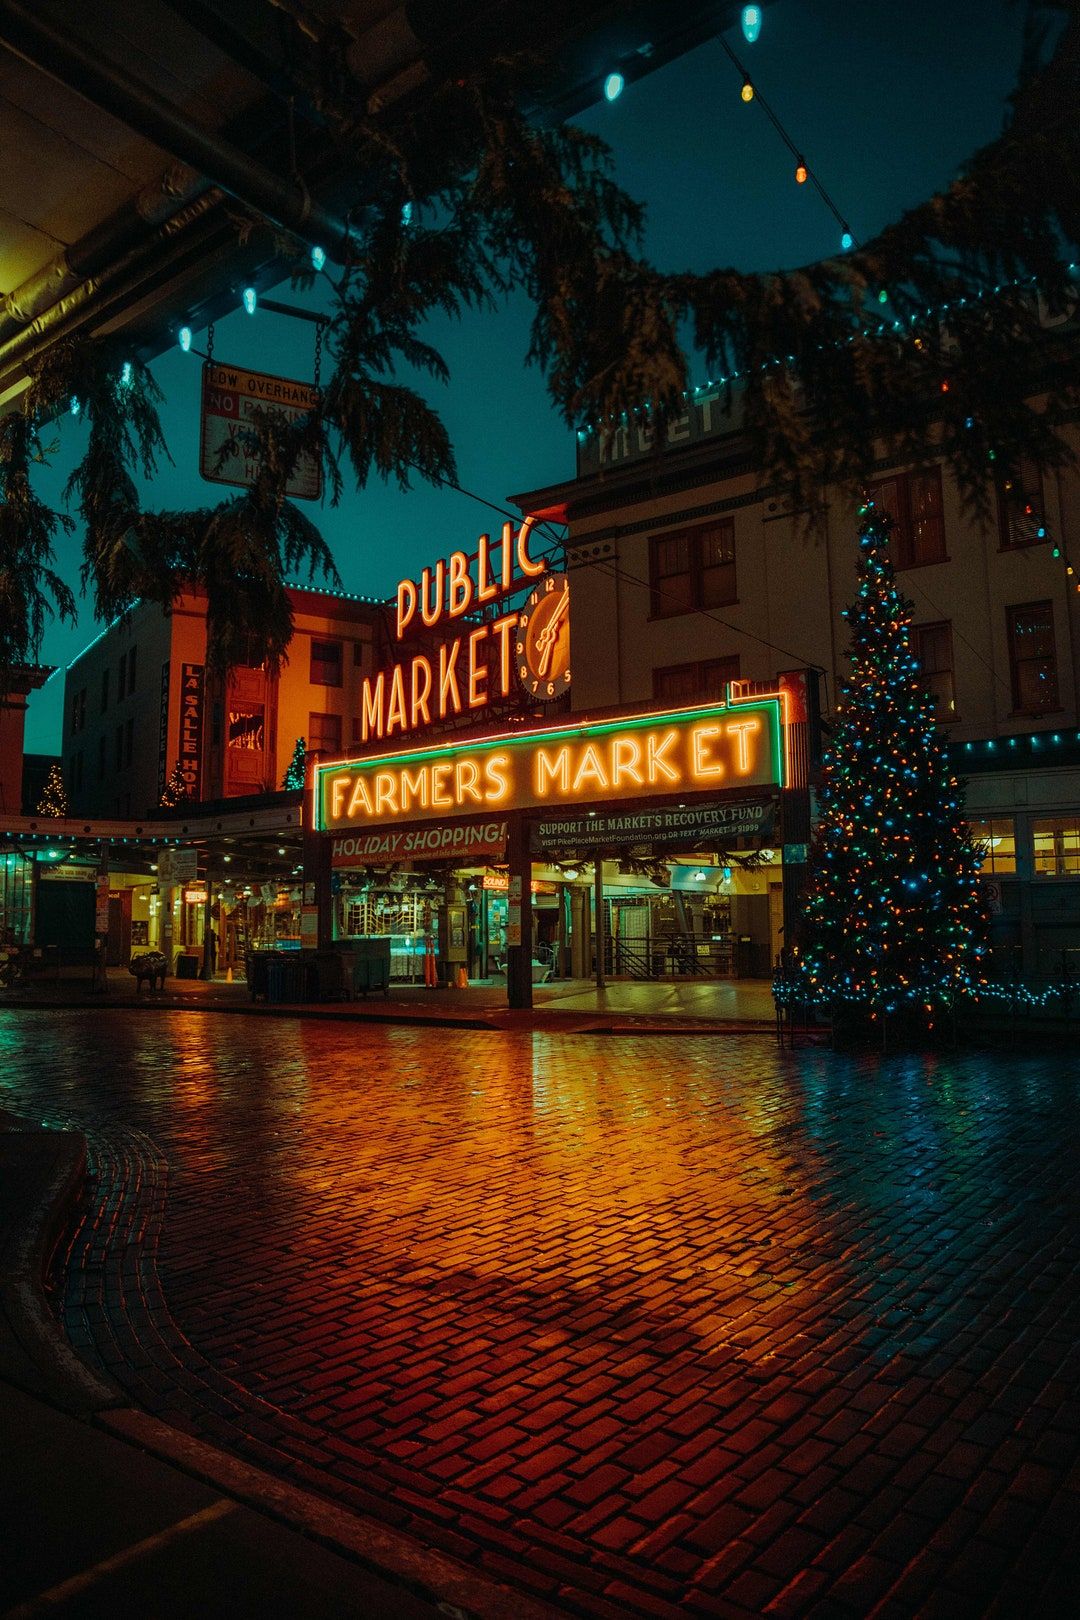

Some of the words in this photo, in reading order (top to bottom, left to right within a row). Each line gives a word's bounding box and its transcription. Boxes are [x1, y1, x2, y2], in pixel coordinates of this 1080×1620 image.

[210, 371, 238, 388] LOW
[210, 394, 234, 412] NO
[397, 516, 547, 641] PUBLIC
[545, 578, 555, 592] 12
[530, 592, 538, 605] 11
[520, 615, 529, 628] 10
[516, 642, 524, 654] 9
[361, 613, 518, 742] MARKET
[520, 666, 528, 678] 8
[564, 669, 571, 682] 5
[532, 680, 539, 692] 7
[546, 682, 555, 695] 6
[331, 755, 509, 818] FARMERS
[536, 721, 760, 797] MARKET
[539, 821, 583, 835] SUPPORT
[586, 819, 605, 832] THE
[607, 814, 662, 830] MARKET'S
[665, 809, 728, 827] RECOVERY
[731, 806, 763, 821] FUND
[332, 834, 403, 857] HOLIDAY
[403, 822, 506, 851] SHOPPING!
